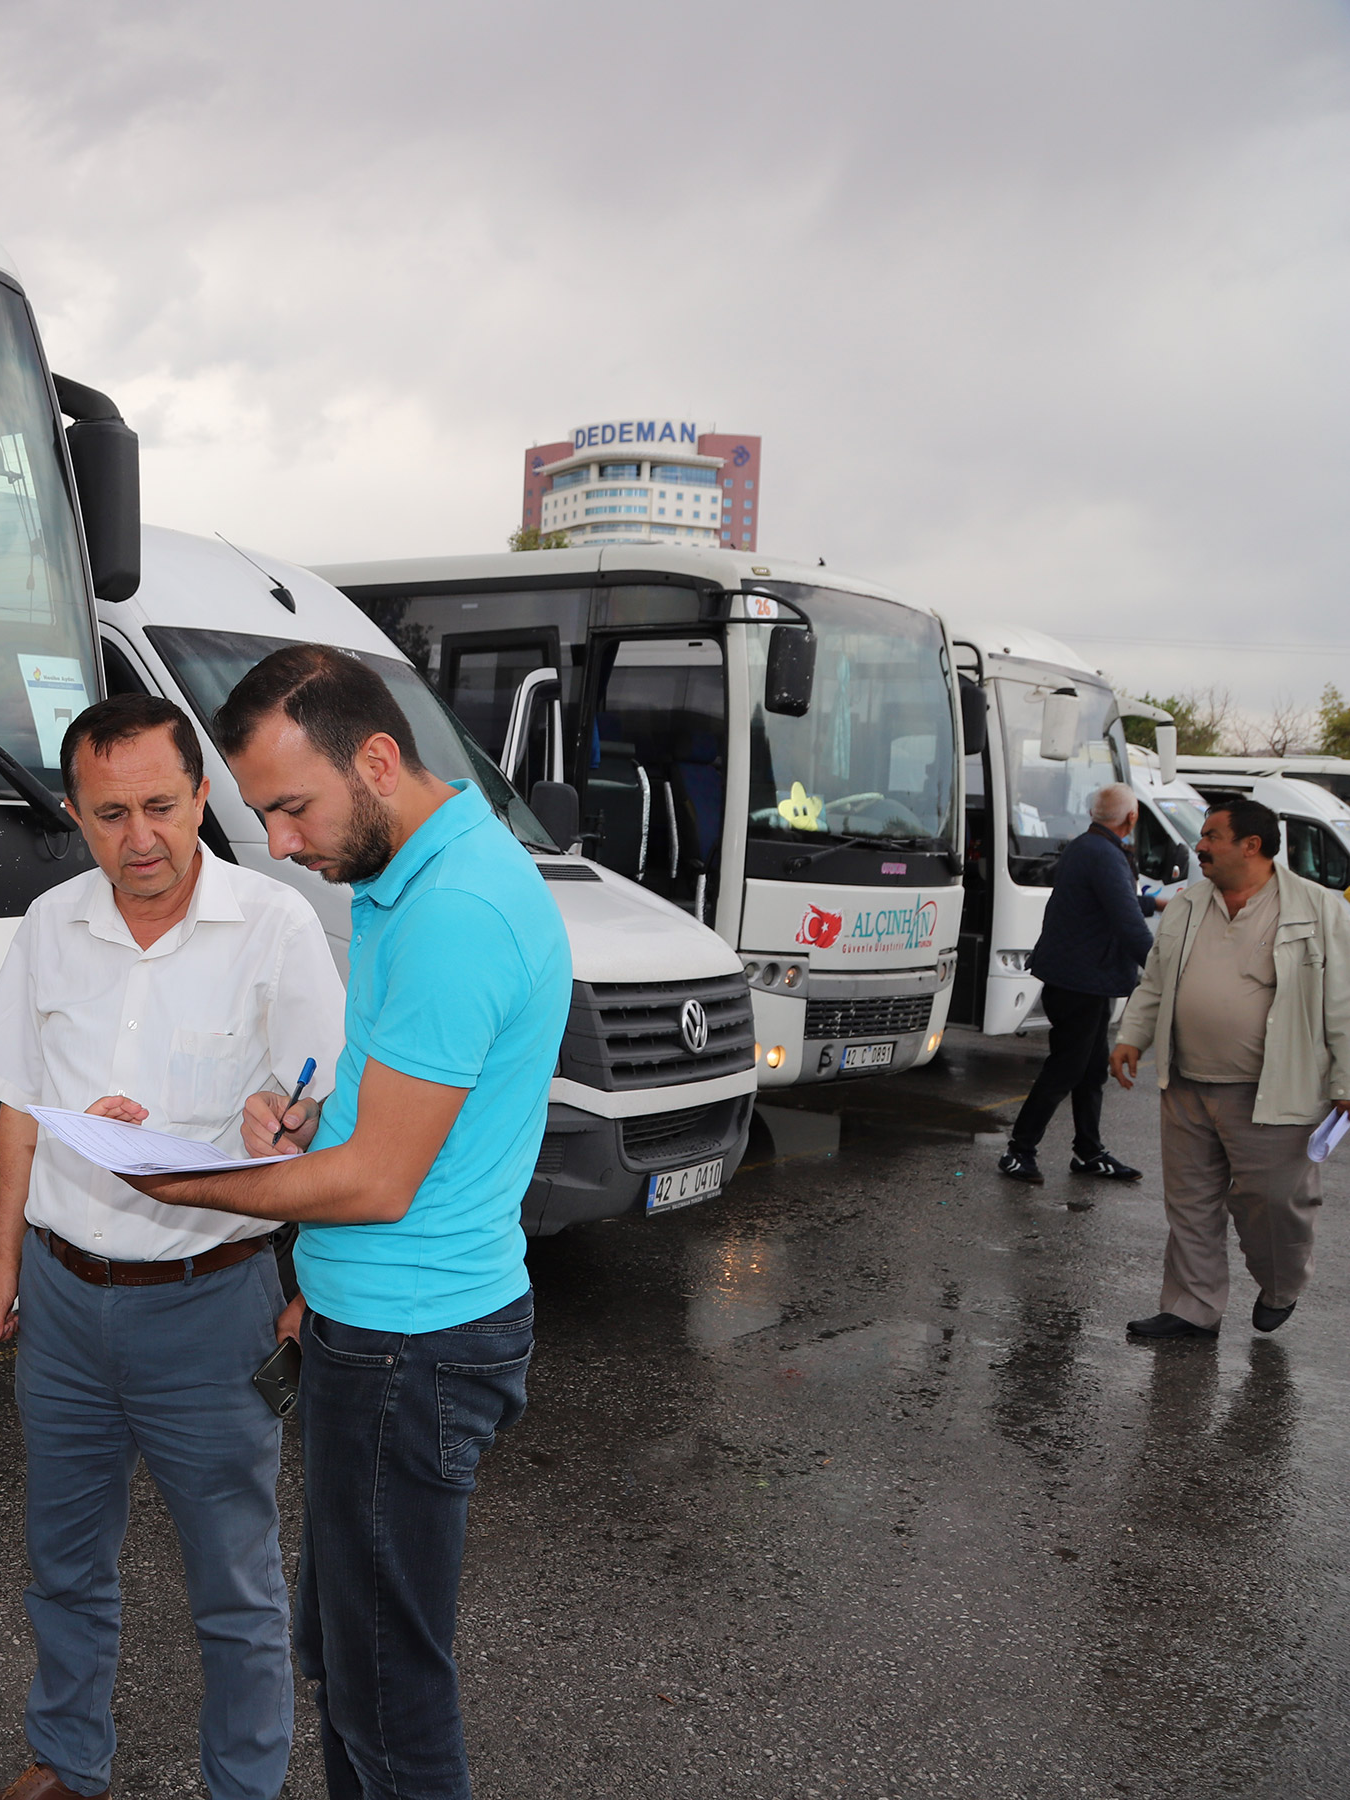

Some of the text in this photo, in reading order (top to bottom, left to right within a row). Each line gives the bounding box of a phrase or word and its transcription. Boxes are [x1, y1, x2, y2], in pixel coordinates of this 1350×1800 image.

[575, 421, 696, 450] DEDEMAN
[754, 597, 771, 616] 26
[846, 1049, 857, 1065] 42
[861, 1048, 868, 1064] C
[655, 1176, 673, 1202] 42
[679, 1171, 689, 1196] C
[694, 1162, 721, 1192] 0410
